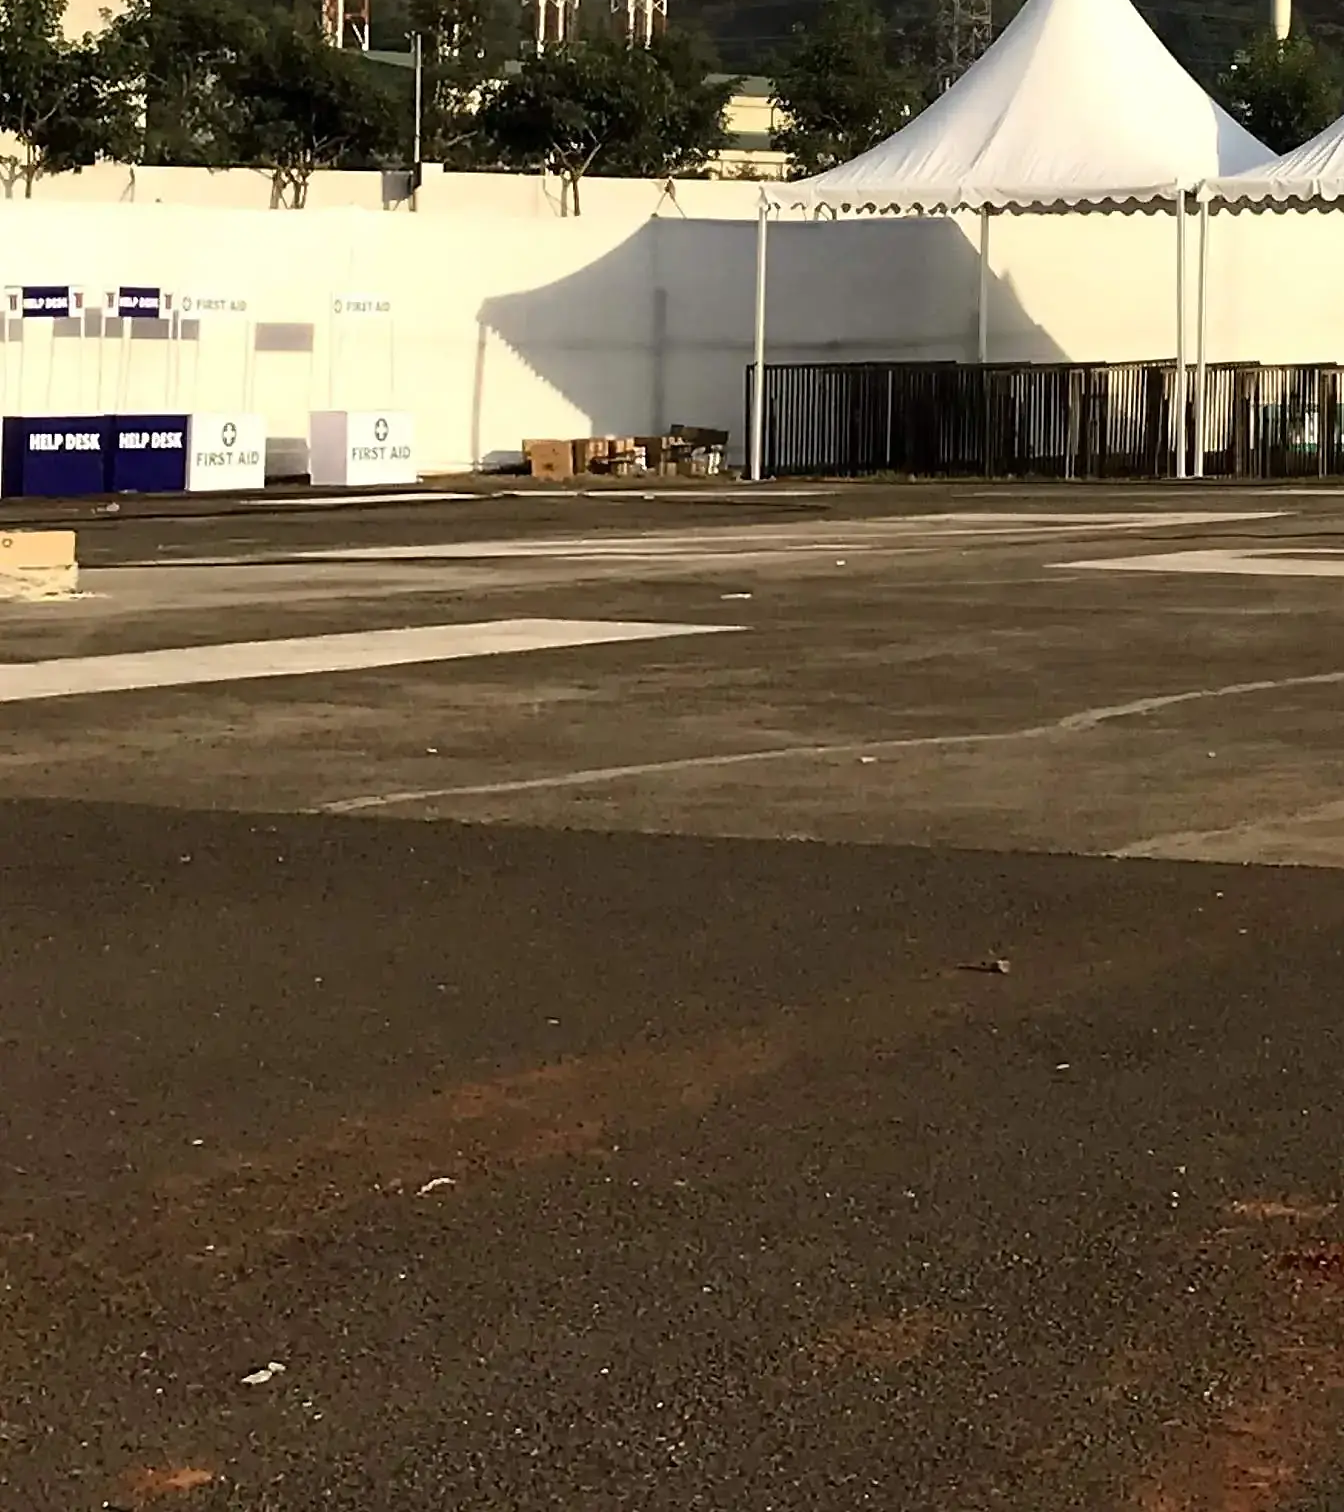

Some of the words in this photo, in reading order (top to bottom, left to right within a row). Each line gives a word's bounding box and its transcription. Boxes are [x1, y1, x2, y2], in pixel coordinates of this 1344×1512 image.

[29, 433, 64, 451] HELP
[65, 433, 101, 451] DESK
[118, 432, 150, 449] HELP
[151, 431, 183, 449] DESK
[196, 452, 234, 467] FIRST
[238, 451, 260, 466] AID
[352, 446, 387, 461] FIRST
[390, 445, 411, 460] AID
